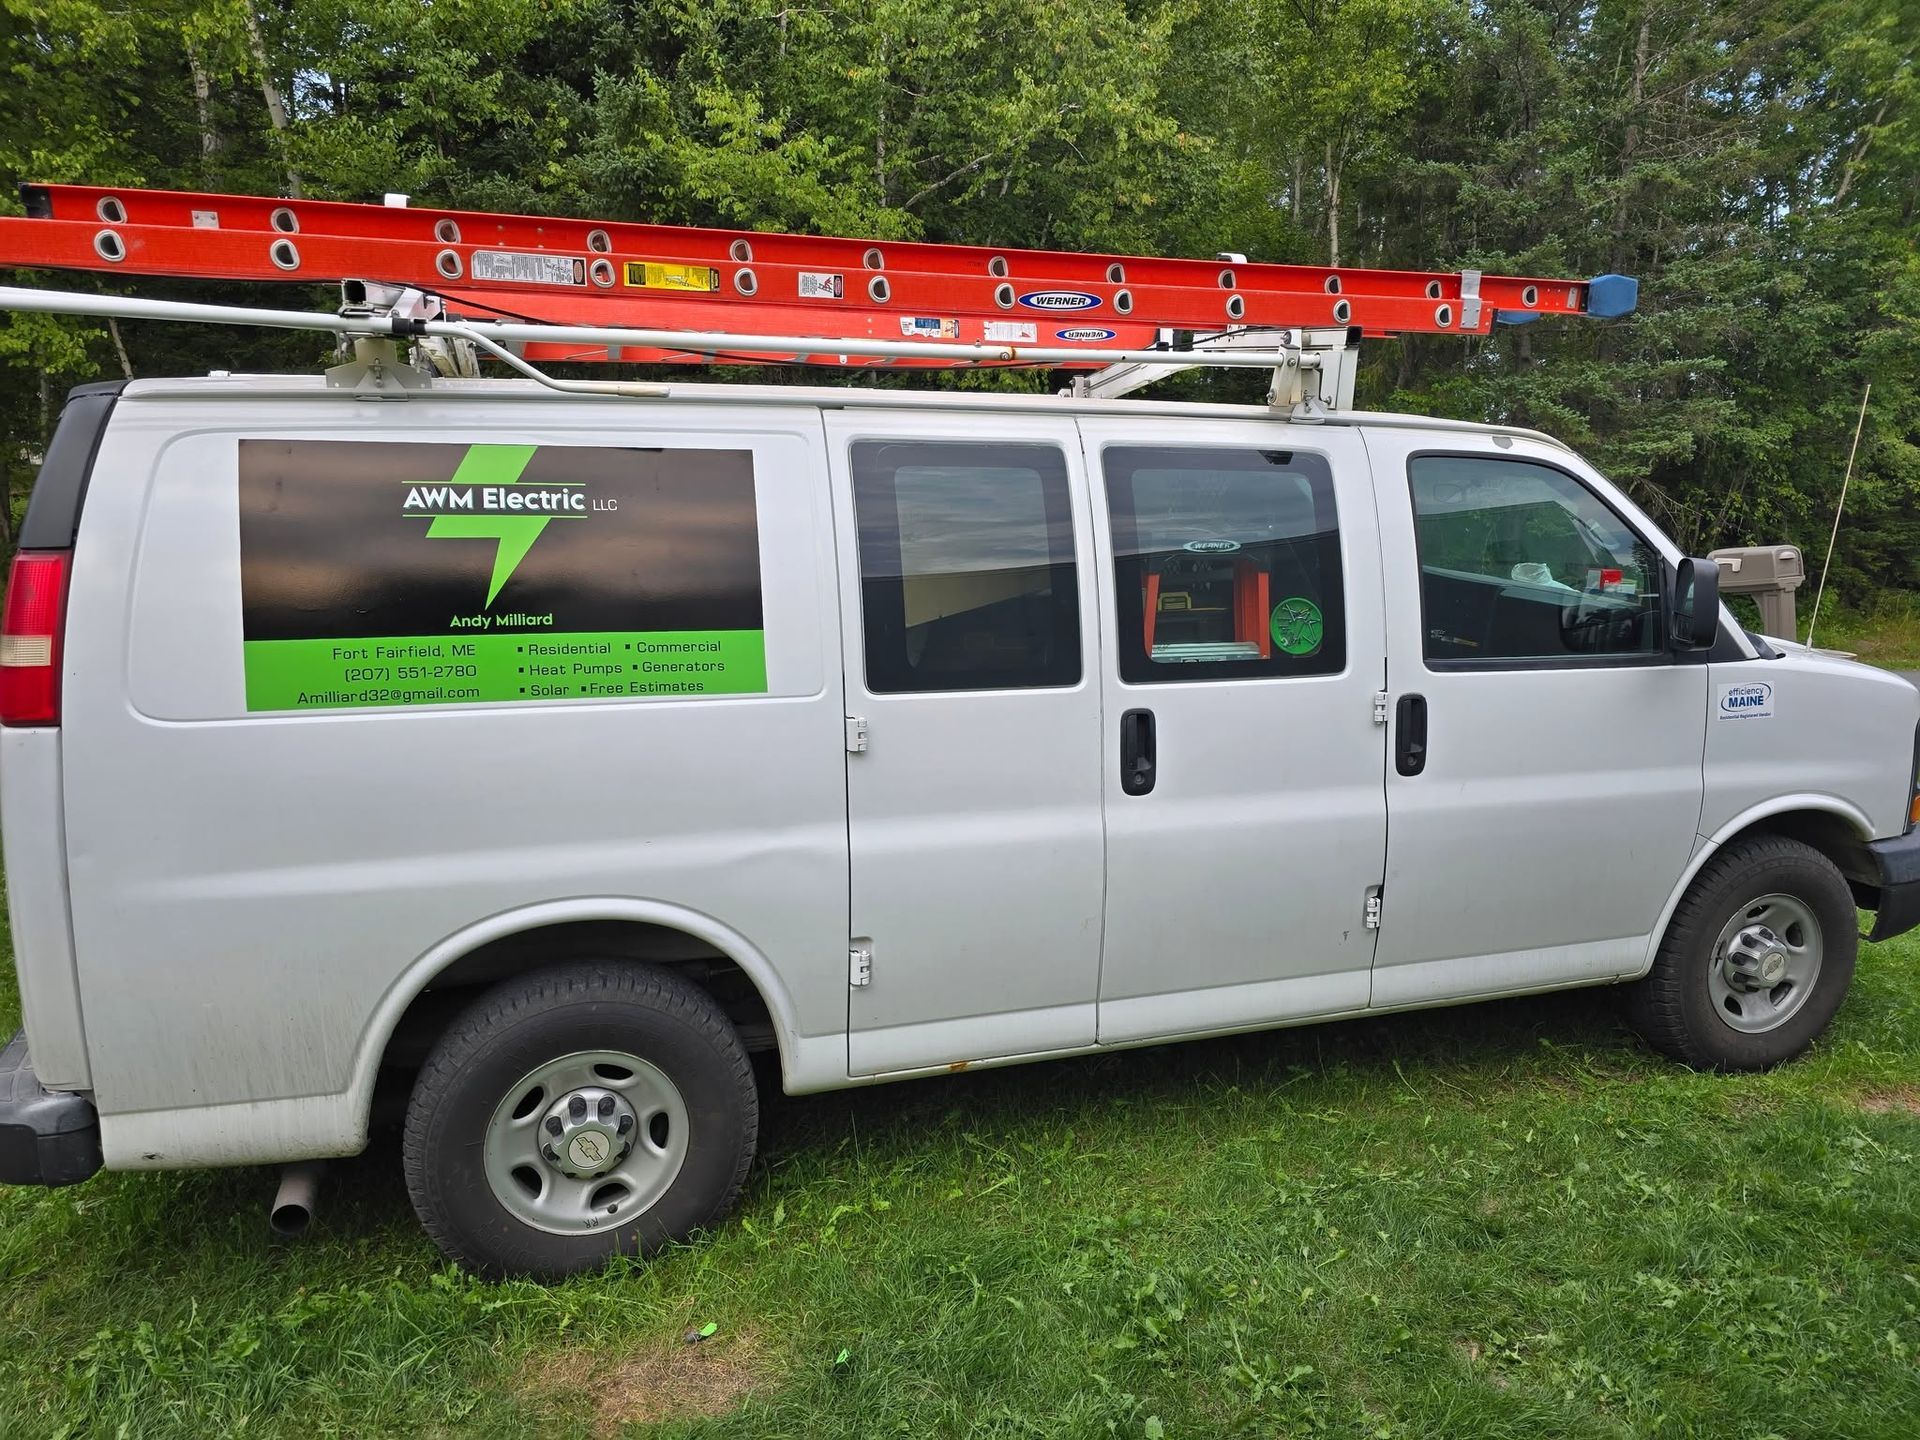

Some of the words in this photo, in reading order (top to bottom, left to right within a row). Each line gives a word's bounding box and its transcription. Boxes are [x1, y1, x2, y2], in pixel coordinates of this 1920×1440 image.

[1036, 296, 1087, 306] WERNER
[1068, 331, 1104, 339] WERNER
[402, 486, 473, 510] AWM
[482, 487, 587, 511] Electric
[592, 499, 618, 511] LLC
[450, 614, 492, 630] Andy
[496, 613, 553, 627] Milliard
[332, 647, 369, 661] Fort
[375, 644, 446, 660] Fairfield,
[452, 644, 476, 657] ME
[528, 642, 611, 656] Residential
[636, 641, 721, 654] Commercial
[344, 667, 391, 683] (207)
[397, 664, 478, 679] 551-2780
[529, 663, 566, 676] Heat
[572, 662, 623, 677] Pumps
[642, 660, 725, 673] Generators
[297, 687, 480, 704] Amilliard32@gmail.com
[530, 683, 570, 697] Solar
[589, 682, 624, 695] Free
[629, 680, 704, 694] Estimates
[1728, 688, 1764, 696] efficiency
[1728, 695, 1764, 708] MAINE
